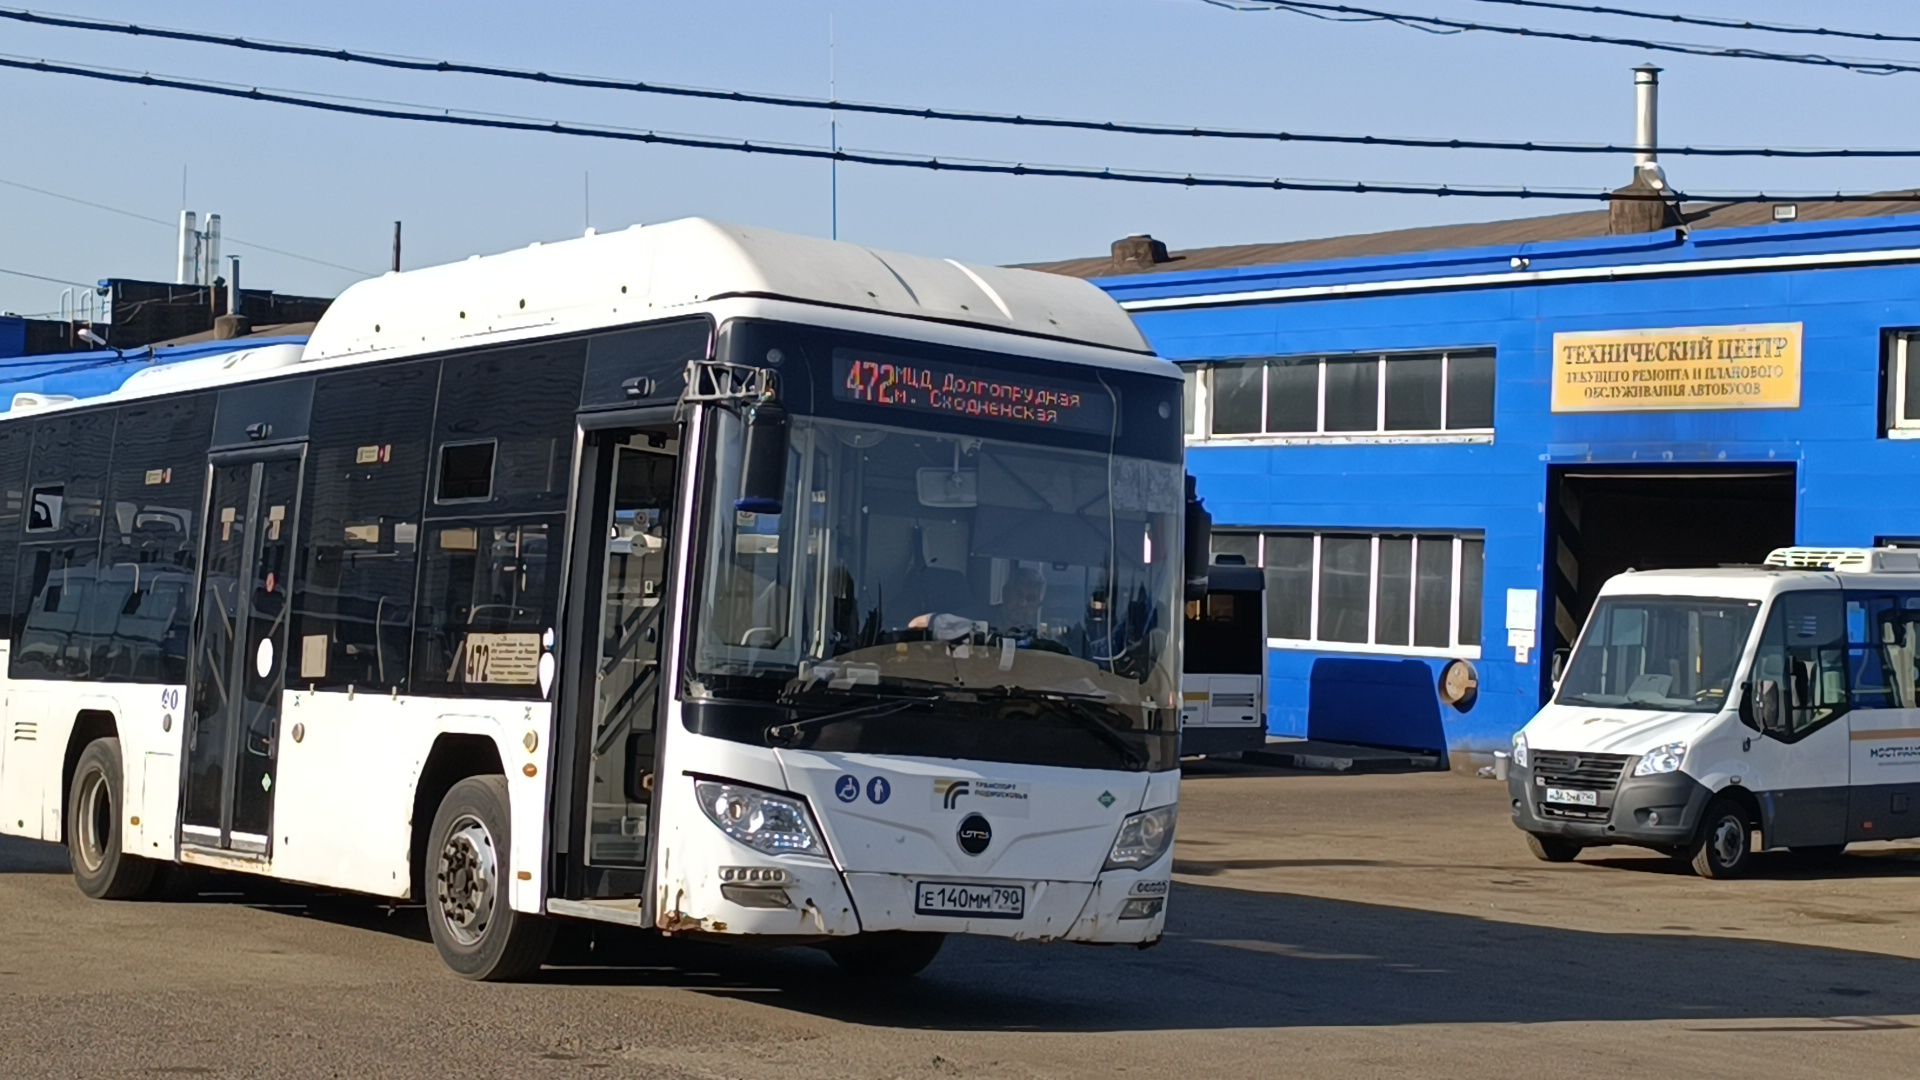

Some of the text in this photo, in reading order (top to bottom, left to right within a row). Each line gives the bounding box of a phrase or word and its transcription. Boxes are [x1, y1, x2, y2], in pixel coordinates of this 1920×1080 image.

[1563, 336, 1788, 364] ТЕХНИЧЕСКИЙ ЦЕНТР
[847, 360, 893, 403] 472
[895, 366, 1080, 407] МЦД Долгопрудная
[1567, 365, 1784, 383] ТЕКУЩЕГО РЕМОНТА И ПЛАНОВОГО
[1584, 382, 1761, 399] ОБСЛУЖИВАНИЯ АВТОБУСОВ
[930, 389, 1058, 422] Сходненская
[467, 644, 489, 682] 472
